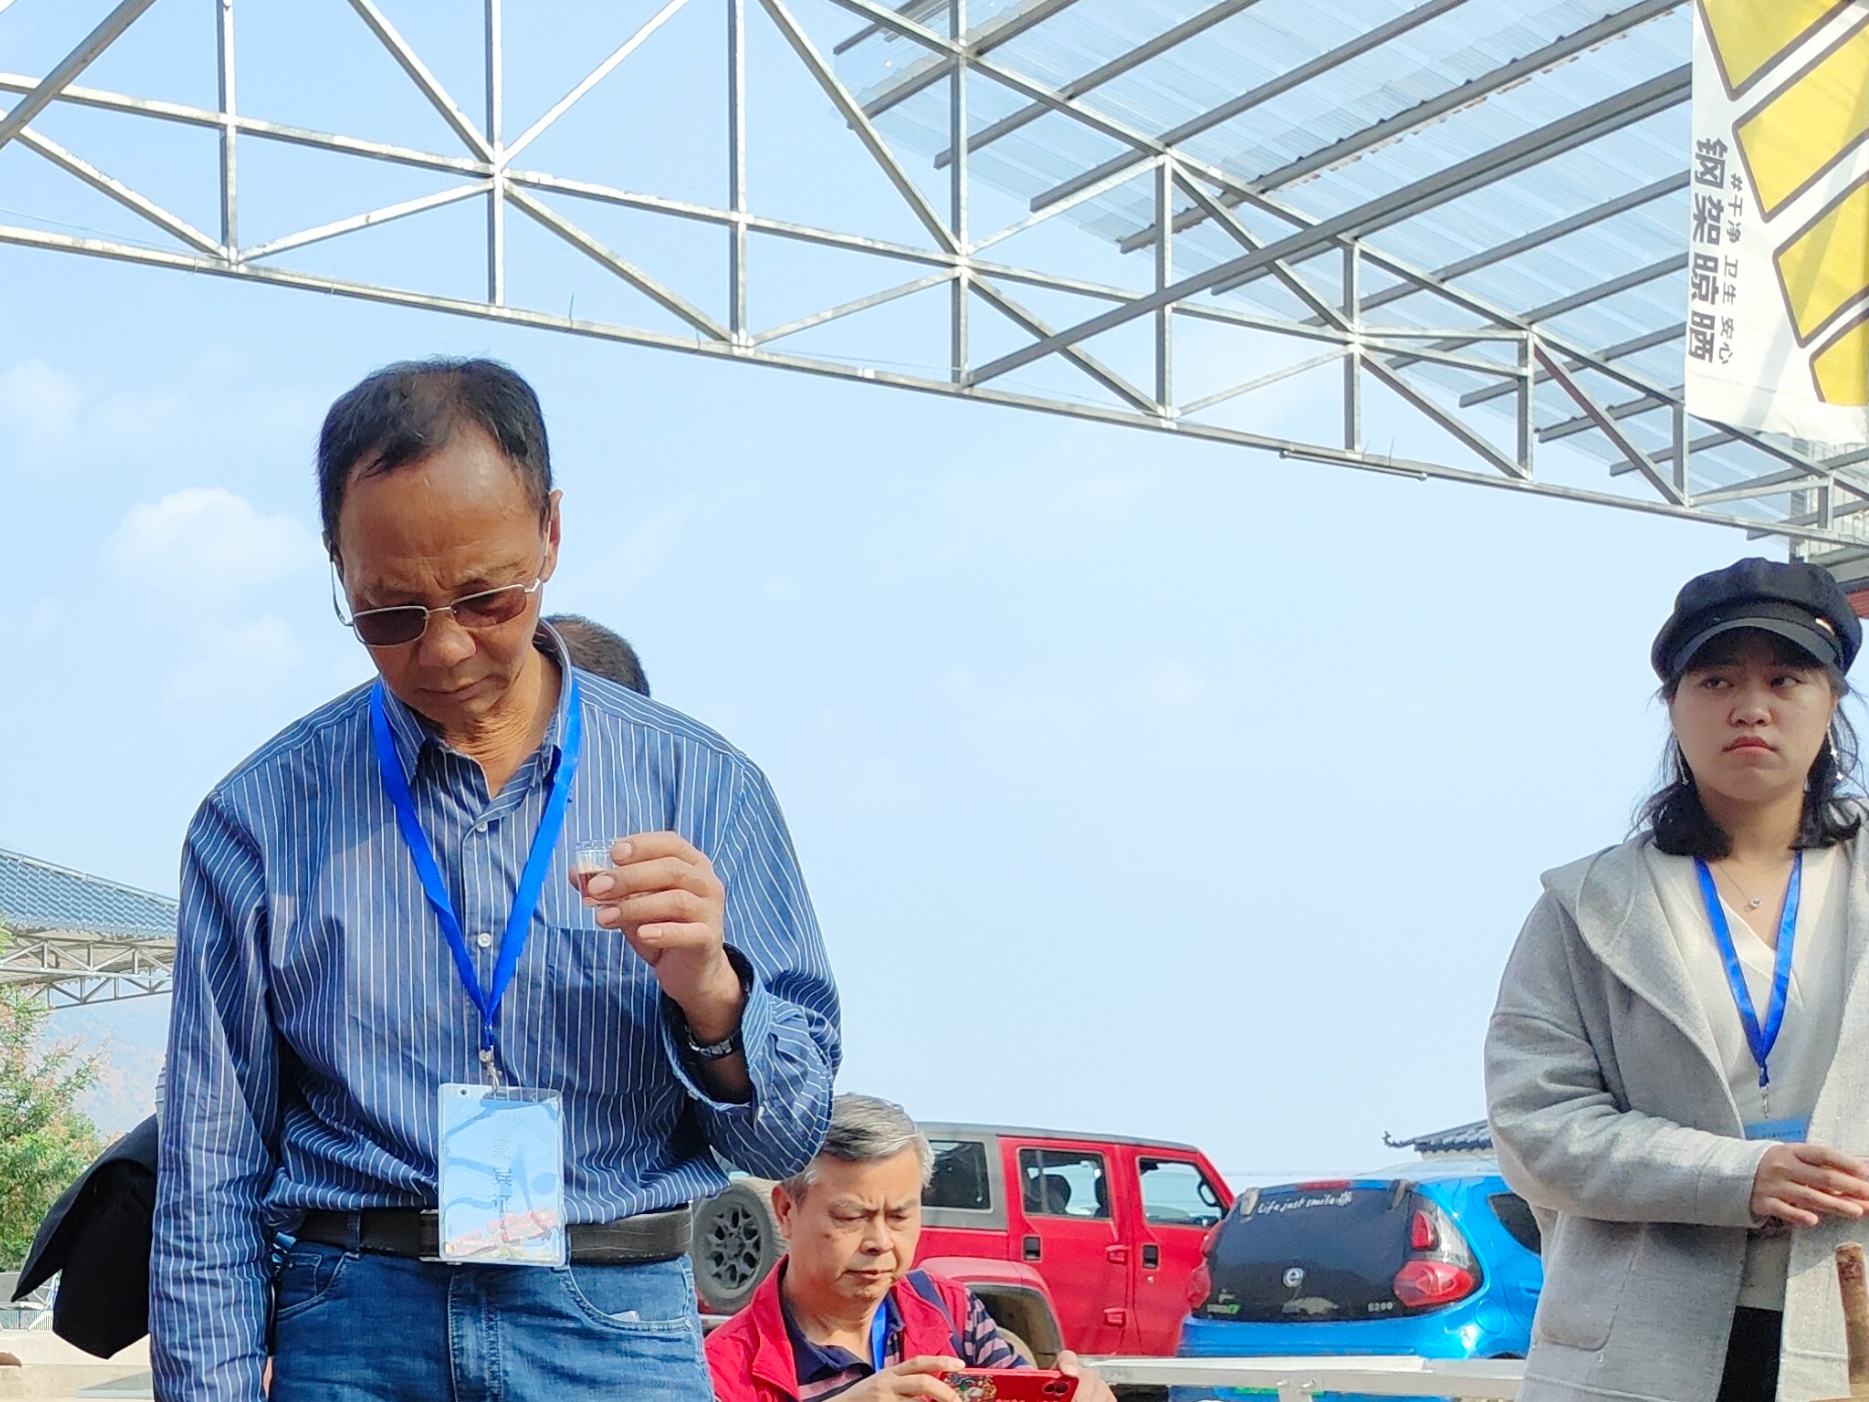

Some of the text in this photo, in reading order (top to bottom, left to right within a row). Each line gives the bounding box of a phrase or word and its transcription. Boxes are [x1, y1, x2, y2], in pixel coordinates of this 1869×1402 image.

[1688, 138, 1728, 363] 钢架晾晒
[1722, 254, 1738, 306] 卫生
[1719, 316, 1734, 365] 安心
